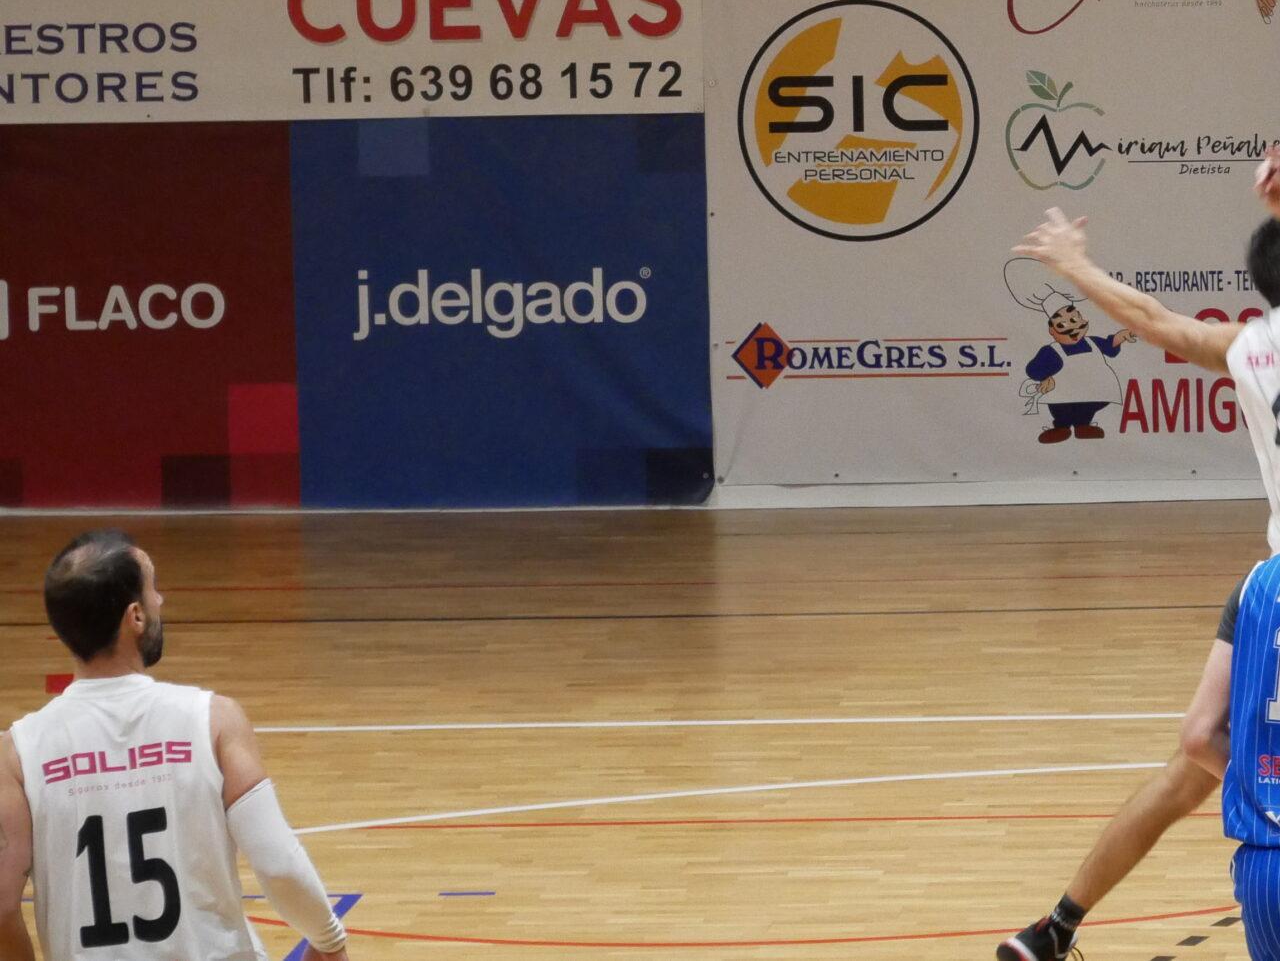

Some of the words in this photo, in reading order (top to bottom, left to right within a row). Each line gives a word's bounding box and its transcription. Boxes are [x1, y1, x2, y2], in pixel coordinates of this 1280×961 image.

[0, 21, 198, 55] ESTROS
[389, 64, 474, 103] 639
[488, 63, 543, 102] 68
[560, 62, 613, 99] 15
[629, 60, 682, 99] 72
[768, 74, 949, 133] SIC
[774, 149, 945, 163] ENTRENAMIENTO
[804, 168, 916, 181] PERSONAL
[1178, 164, 1231, 175] Dietista
[1135, 270, 1223, 292] RESTAURANTE
[28, 283, 225, 332] FLACO
[957, 344, 1011, 369] S.L.
[1119, 377, 1252, 434] AMIG
[42, 742, 192, 784] SOLISS
[76, 807, 181, 948] 15
